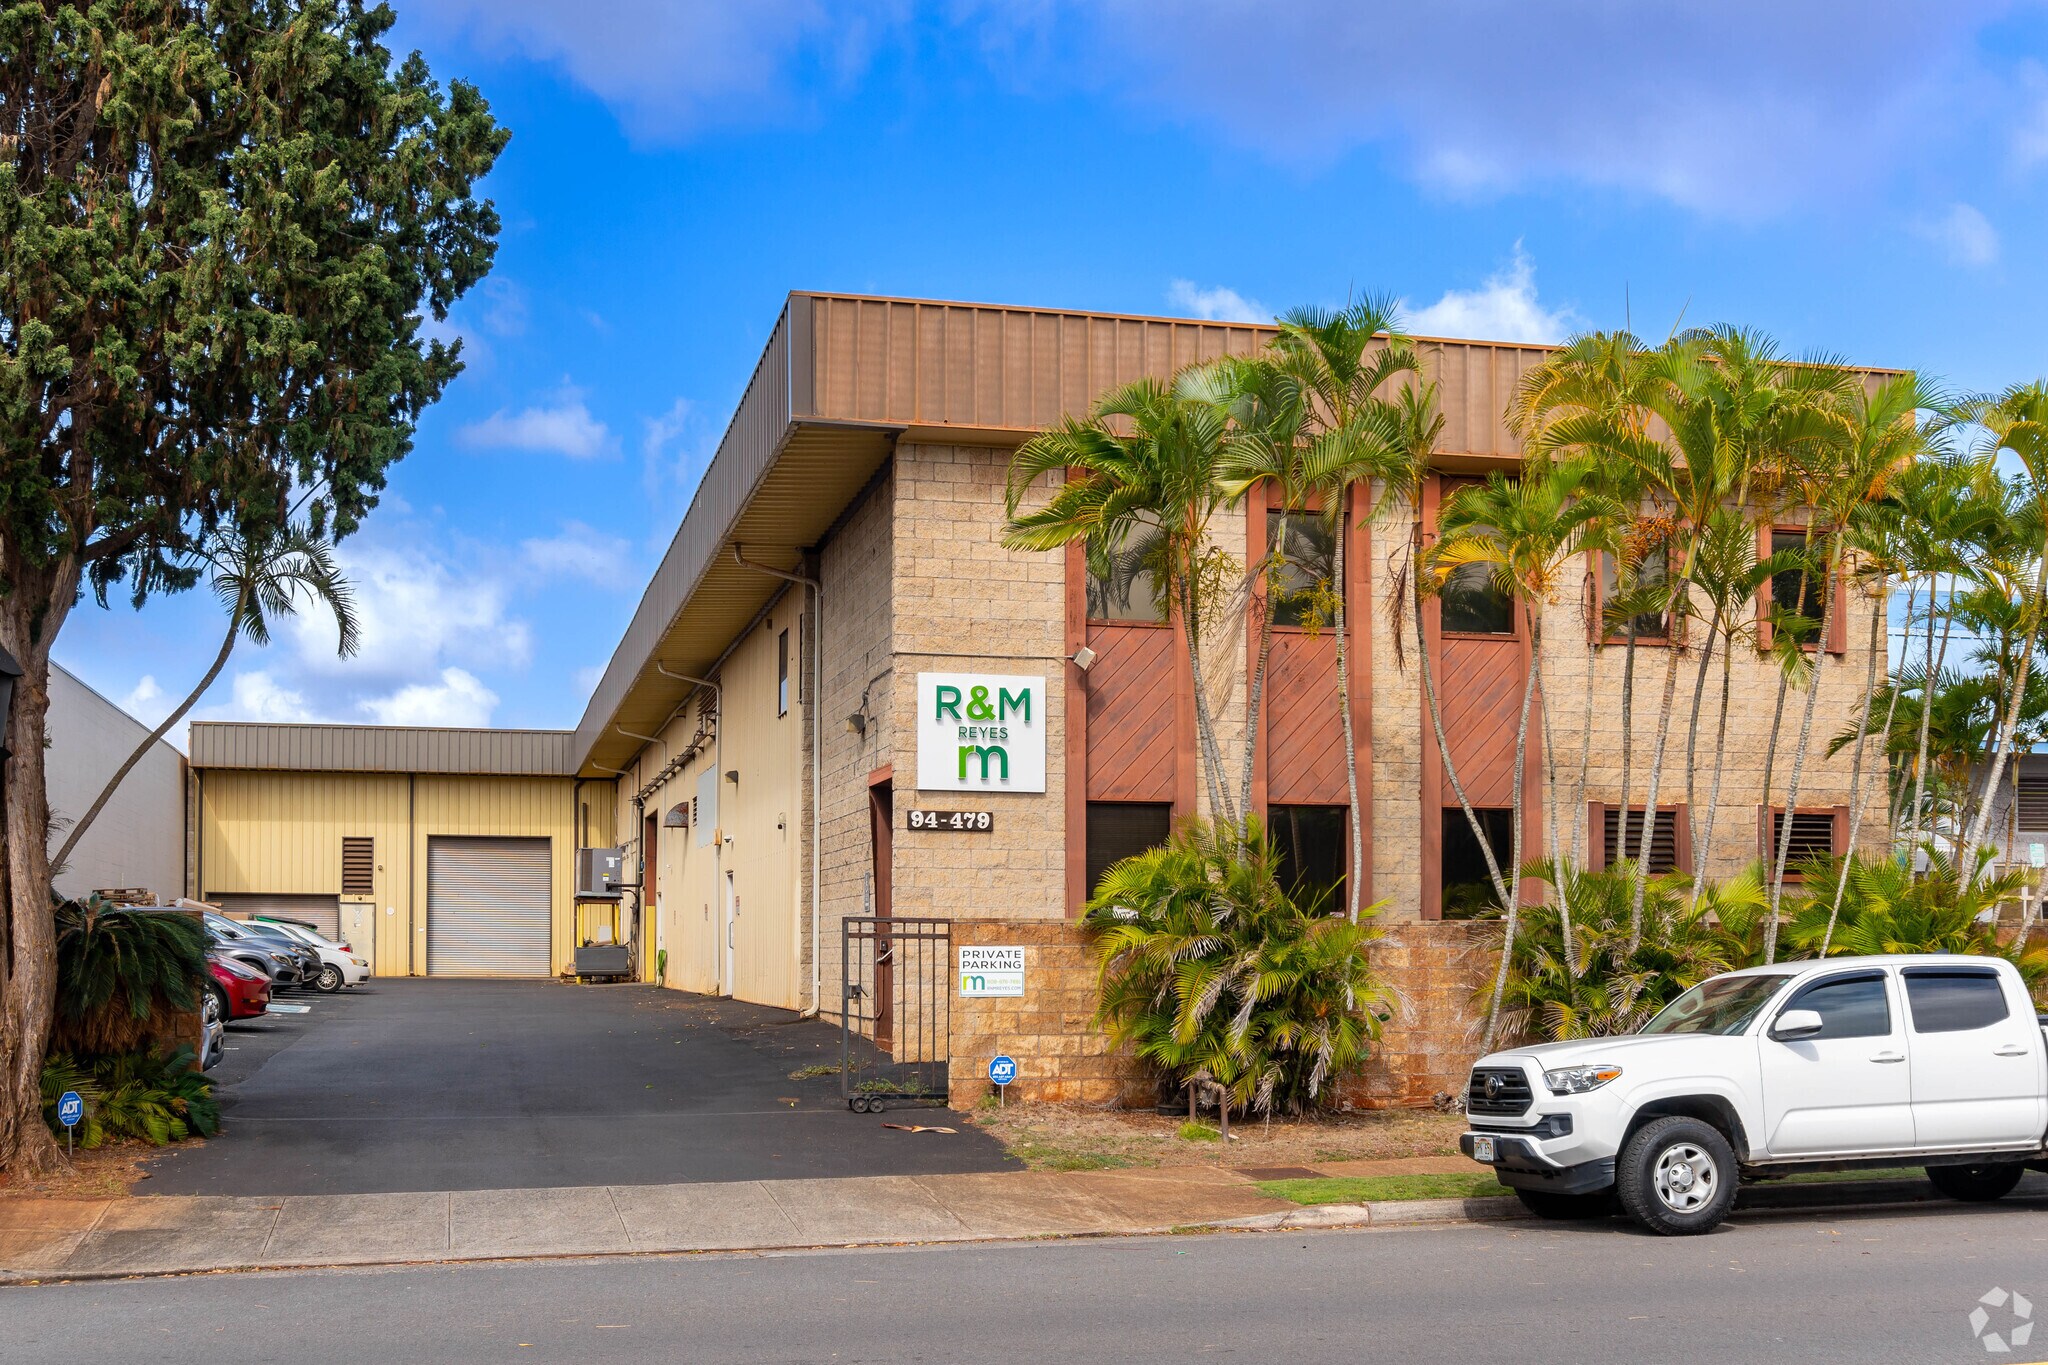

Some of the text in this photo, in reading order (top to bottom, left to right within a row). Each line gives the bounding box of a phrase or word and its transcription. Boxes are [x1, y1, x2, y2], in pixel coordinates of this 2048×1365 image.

[935, 685, 1031, 722] R&M
[958, 726, 1009, 739] REYES
[958, 745, 1009, 780] rm
[910, 811, 991, 829] 94-479
[962, 950, 1022, 959] PRIVATE
[962, 960, 1022, 969] PARKING
[992, 1064, 1013, 1075] ADT
[62, 1101, 79, 1115] ADT
